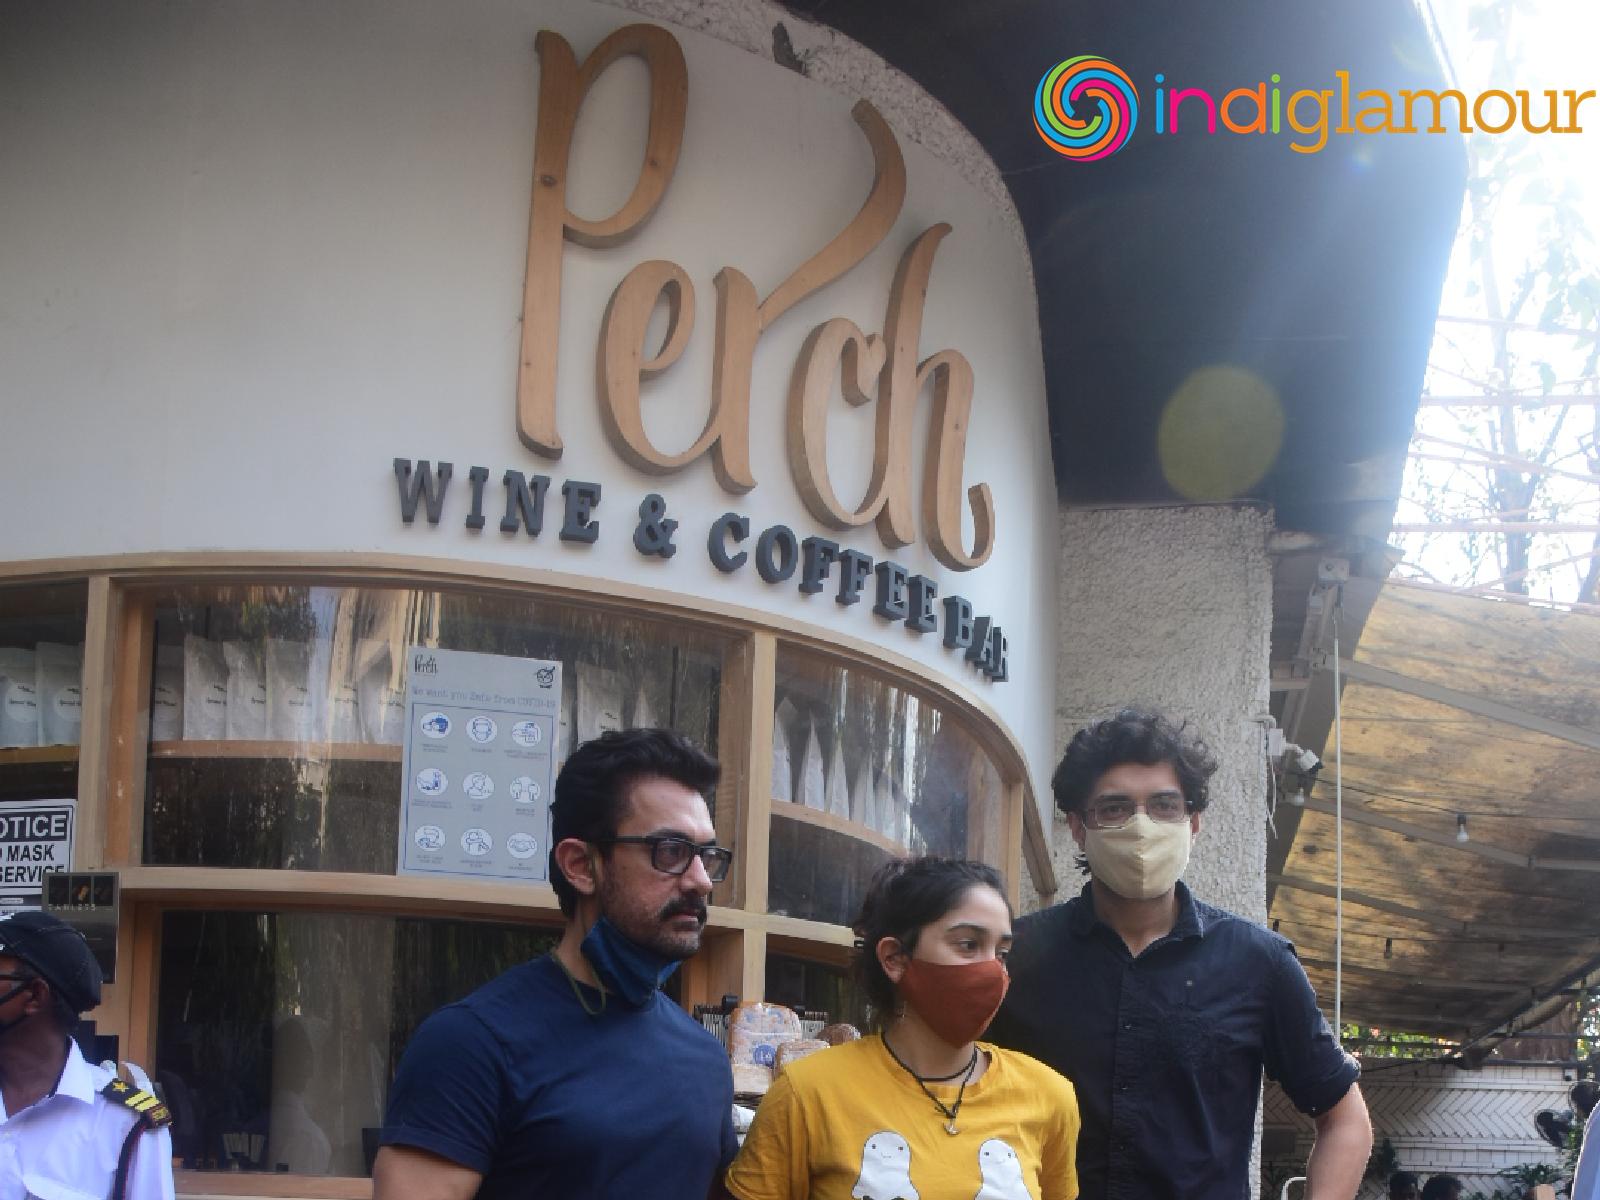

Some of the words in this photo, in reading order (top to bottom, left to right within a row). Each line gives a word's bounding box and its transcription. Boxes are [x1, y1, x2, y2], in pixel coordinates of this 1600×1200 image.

[516, 22, 995, 573] Perch
[393, 457, 601, 544] WINE
[633, 493, 678, 559] &
[708, 512, 938, 633] COFFEE
[0, 814, 67, 838] OTICE
[7, 844, 55, 861] MASK
